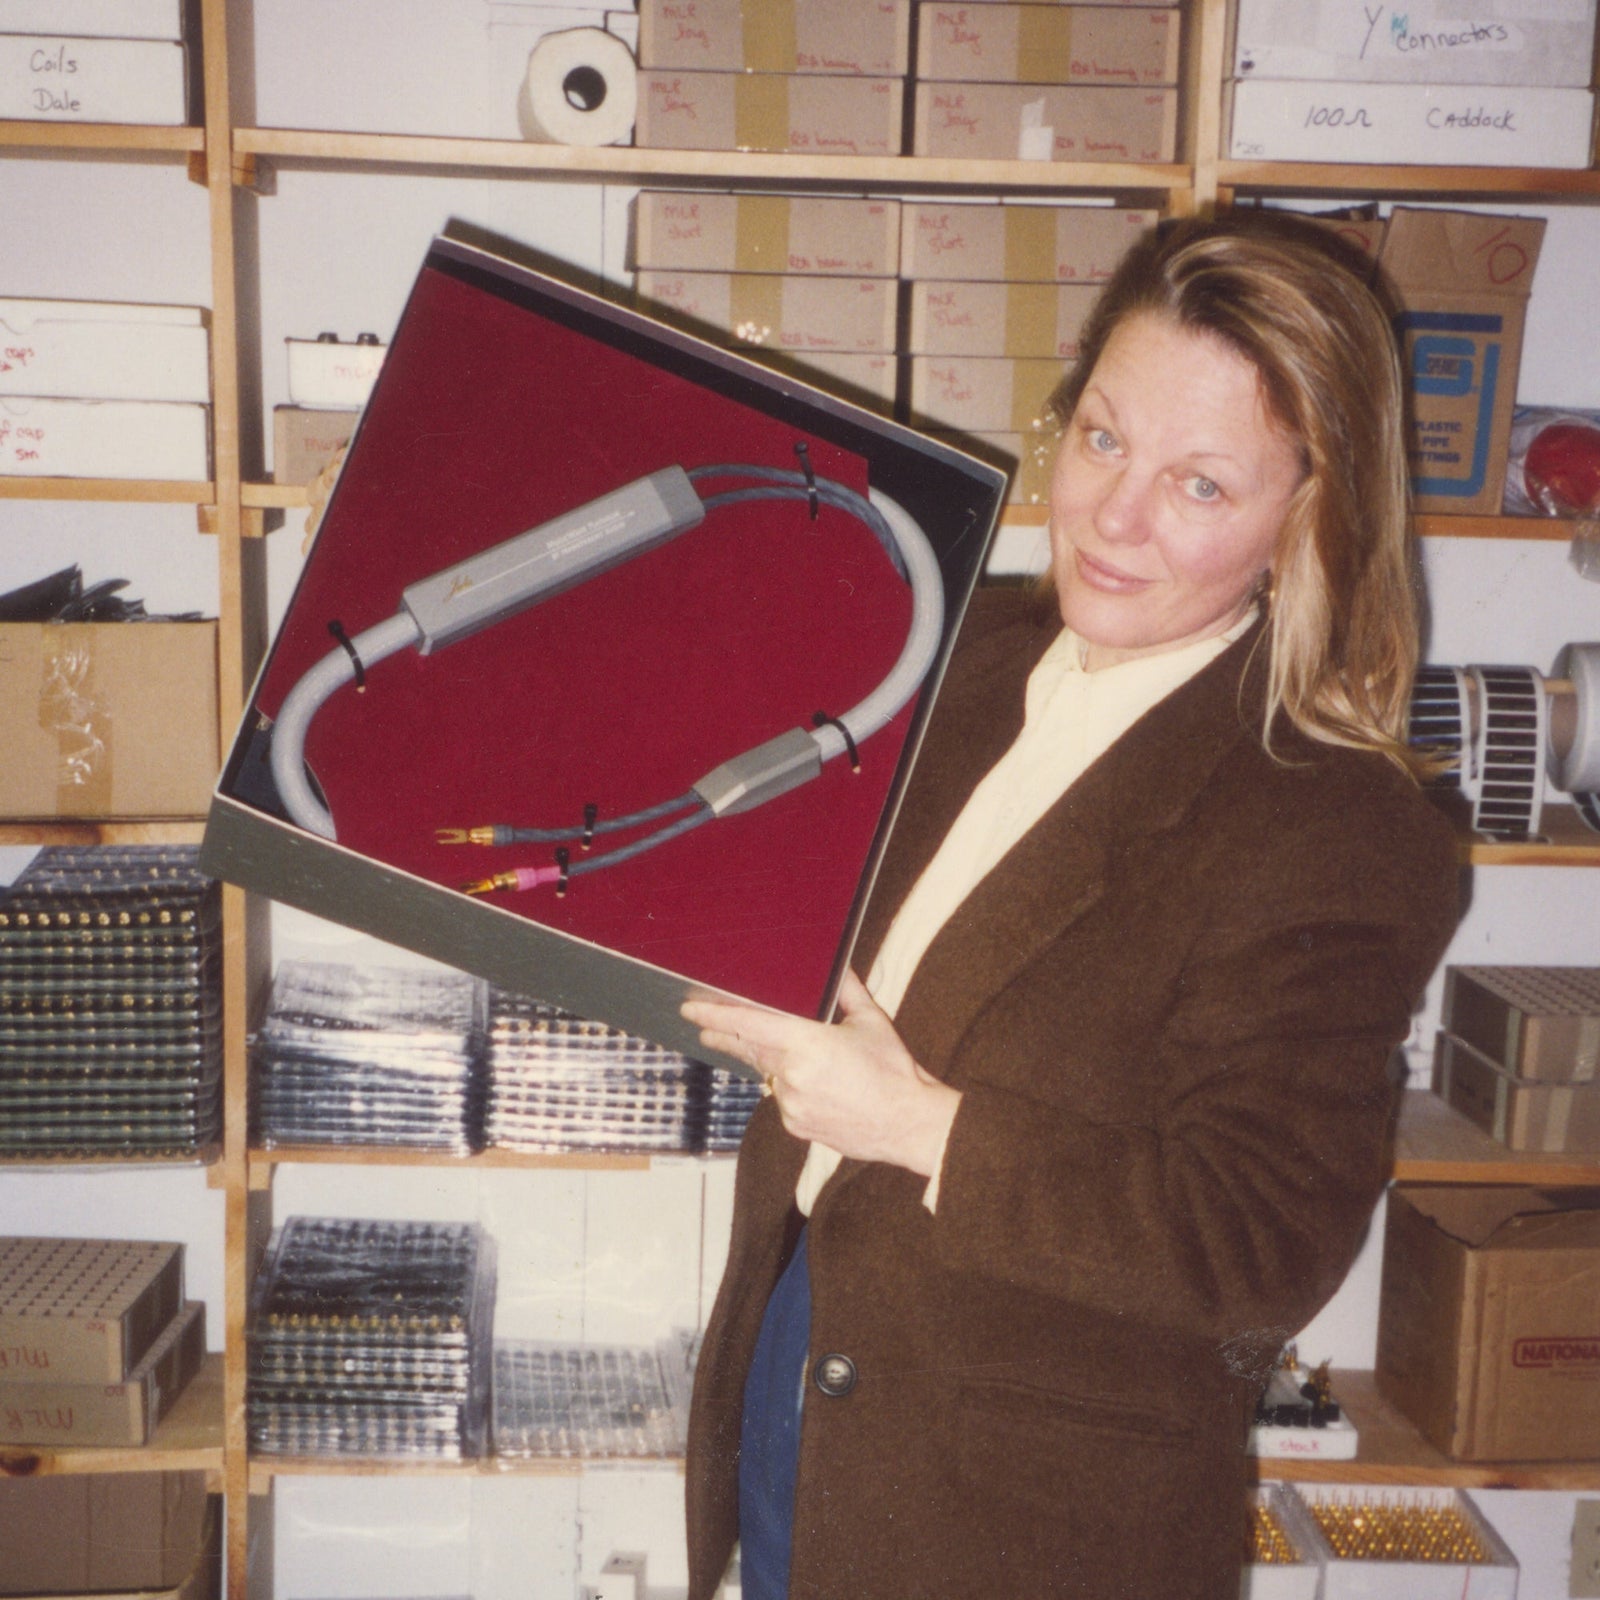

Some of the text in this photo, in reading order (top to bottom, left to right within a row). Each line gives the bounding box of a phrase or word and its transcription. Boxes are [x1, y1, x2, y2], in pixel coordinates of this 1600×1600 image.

[1360, 5, 1385, 60] Y
[29, 46, 79, 74] Coils
[32, 88, 82, 113] Dale
[1412, 420, 1462, 434] PLASTIC
[1422, 435, 1450, 449] PIPE
[1409, 449, 1461, 464] ITTINGS
